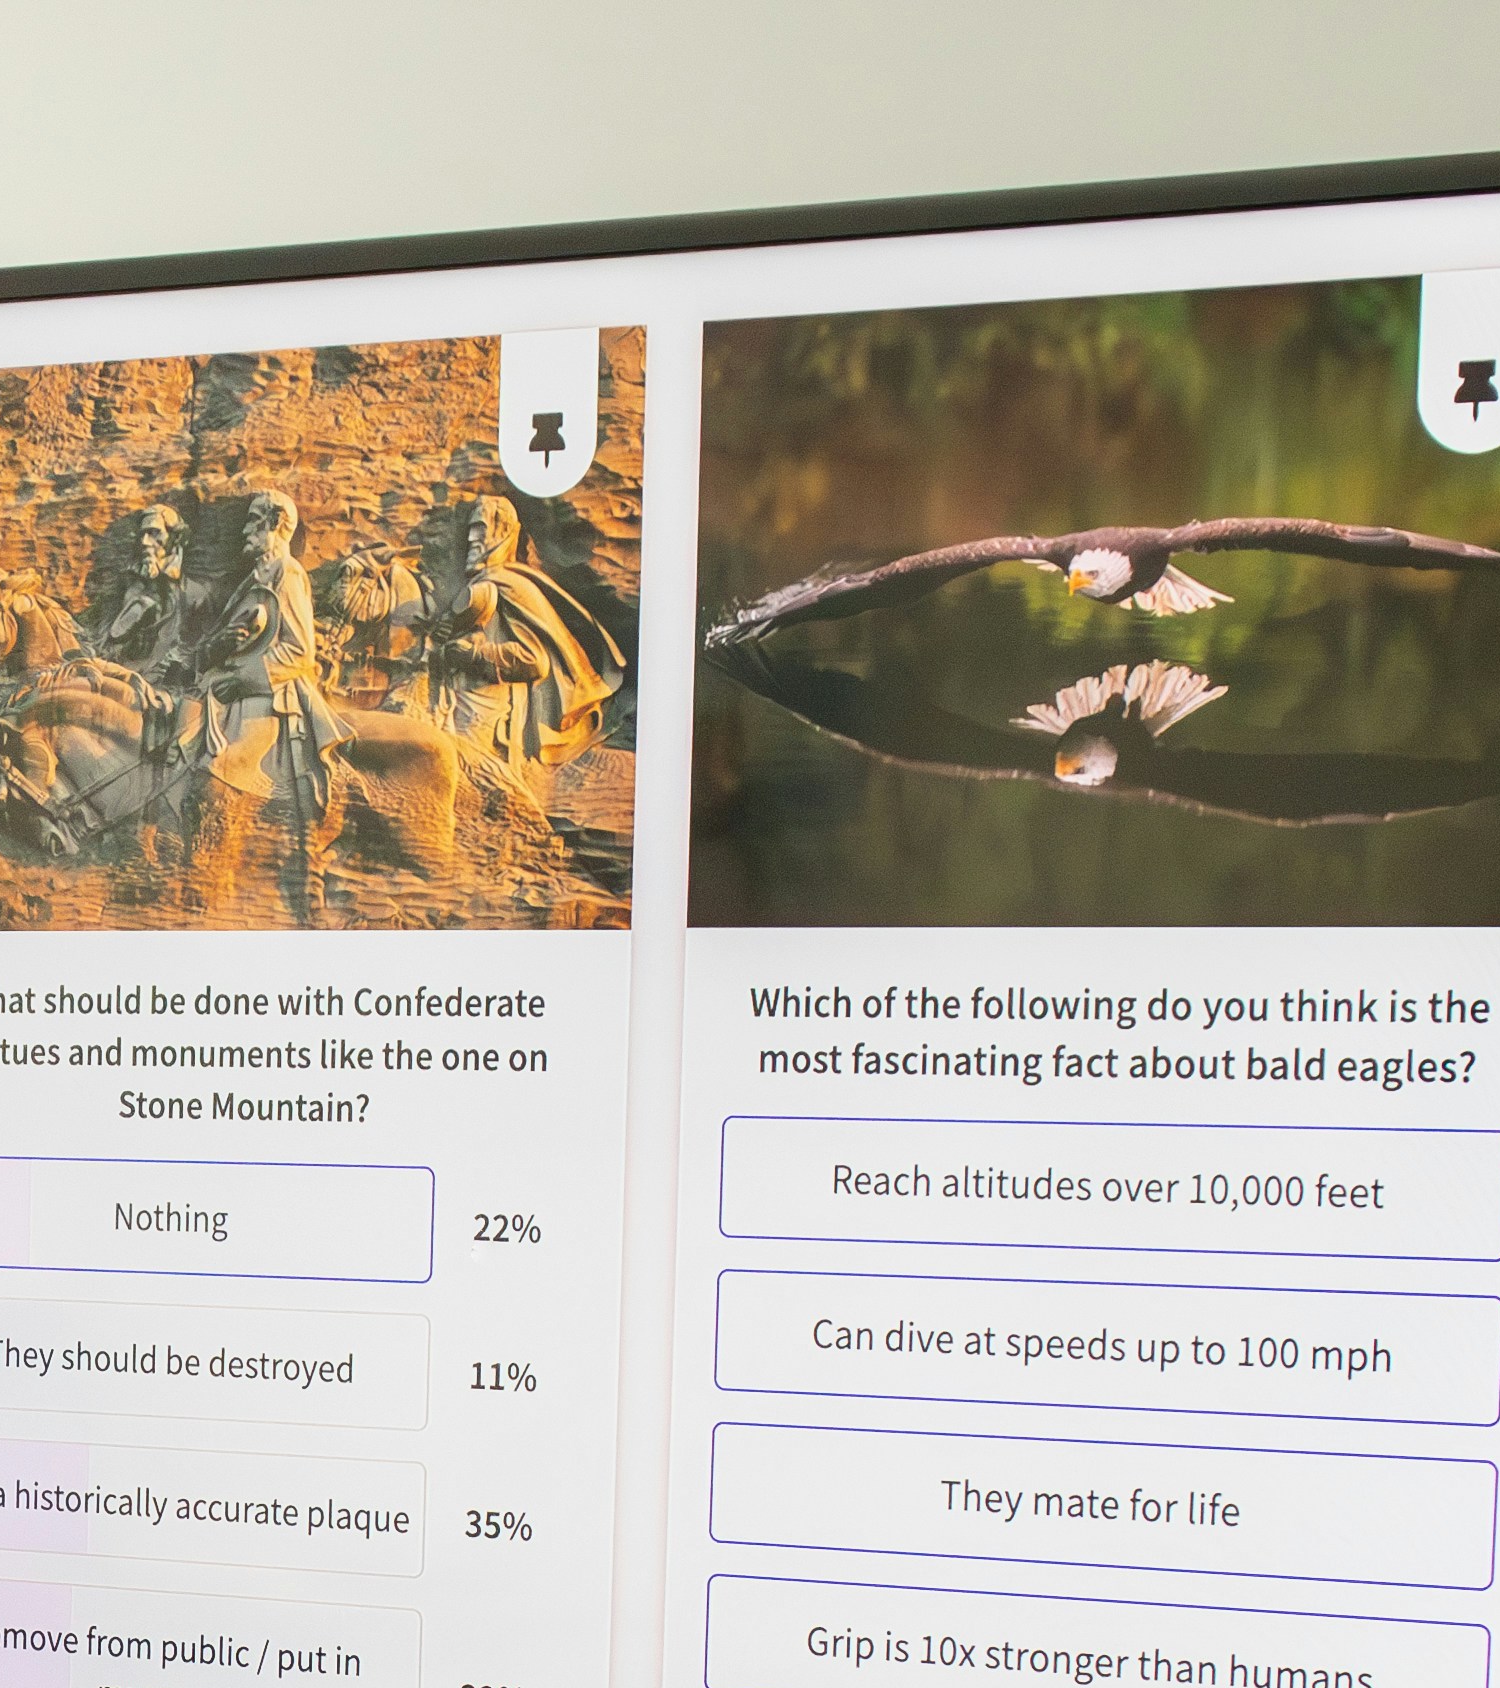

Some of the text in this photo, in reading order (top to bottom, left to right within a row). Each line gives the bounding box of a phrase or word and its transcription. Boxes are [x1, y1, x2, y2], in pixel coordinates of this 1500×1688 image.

[43, 984, 141, 1015] should
[151, 984, 186, 1015] be
[194, 985, 269, 1016] done
[277, 985, 344, 1016] with
[354, 985, 546, 1018] Confederate
[750, 985, 1490, 1030] Which of the following do you think is the
[759, 1041, 1476, 1092] most fascinating fact about bald eagles?
[118, 1090, 370, 1123] Stone Mountain?
[833, 1163, 1385, 1212] Reach altitudes over 10,000 feet
[115, 1201, 229, 1243] Nothing
[473, 1213, 542, 1244] 22%
[470, 1361, 537, 1393] 11%
[15, 1479, 168, 1526] historically
[176, 1498, 299, 1527] accurate
[307, 1498, 410, 1540] plaque
[465, 1509, 533, 1542] 35%
